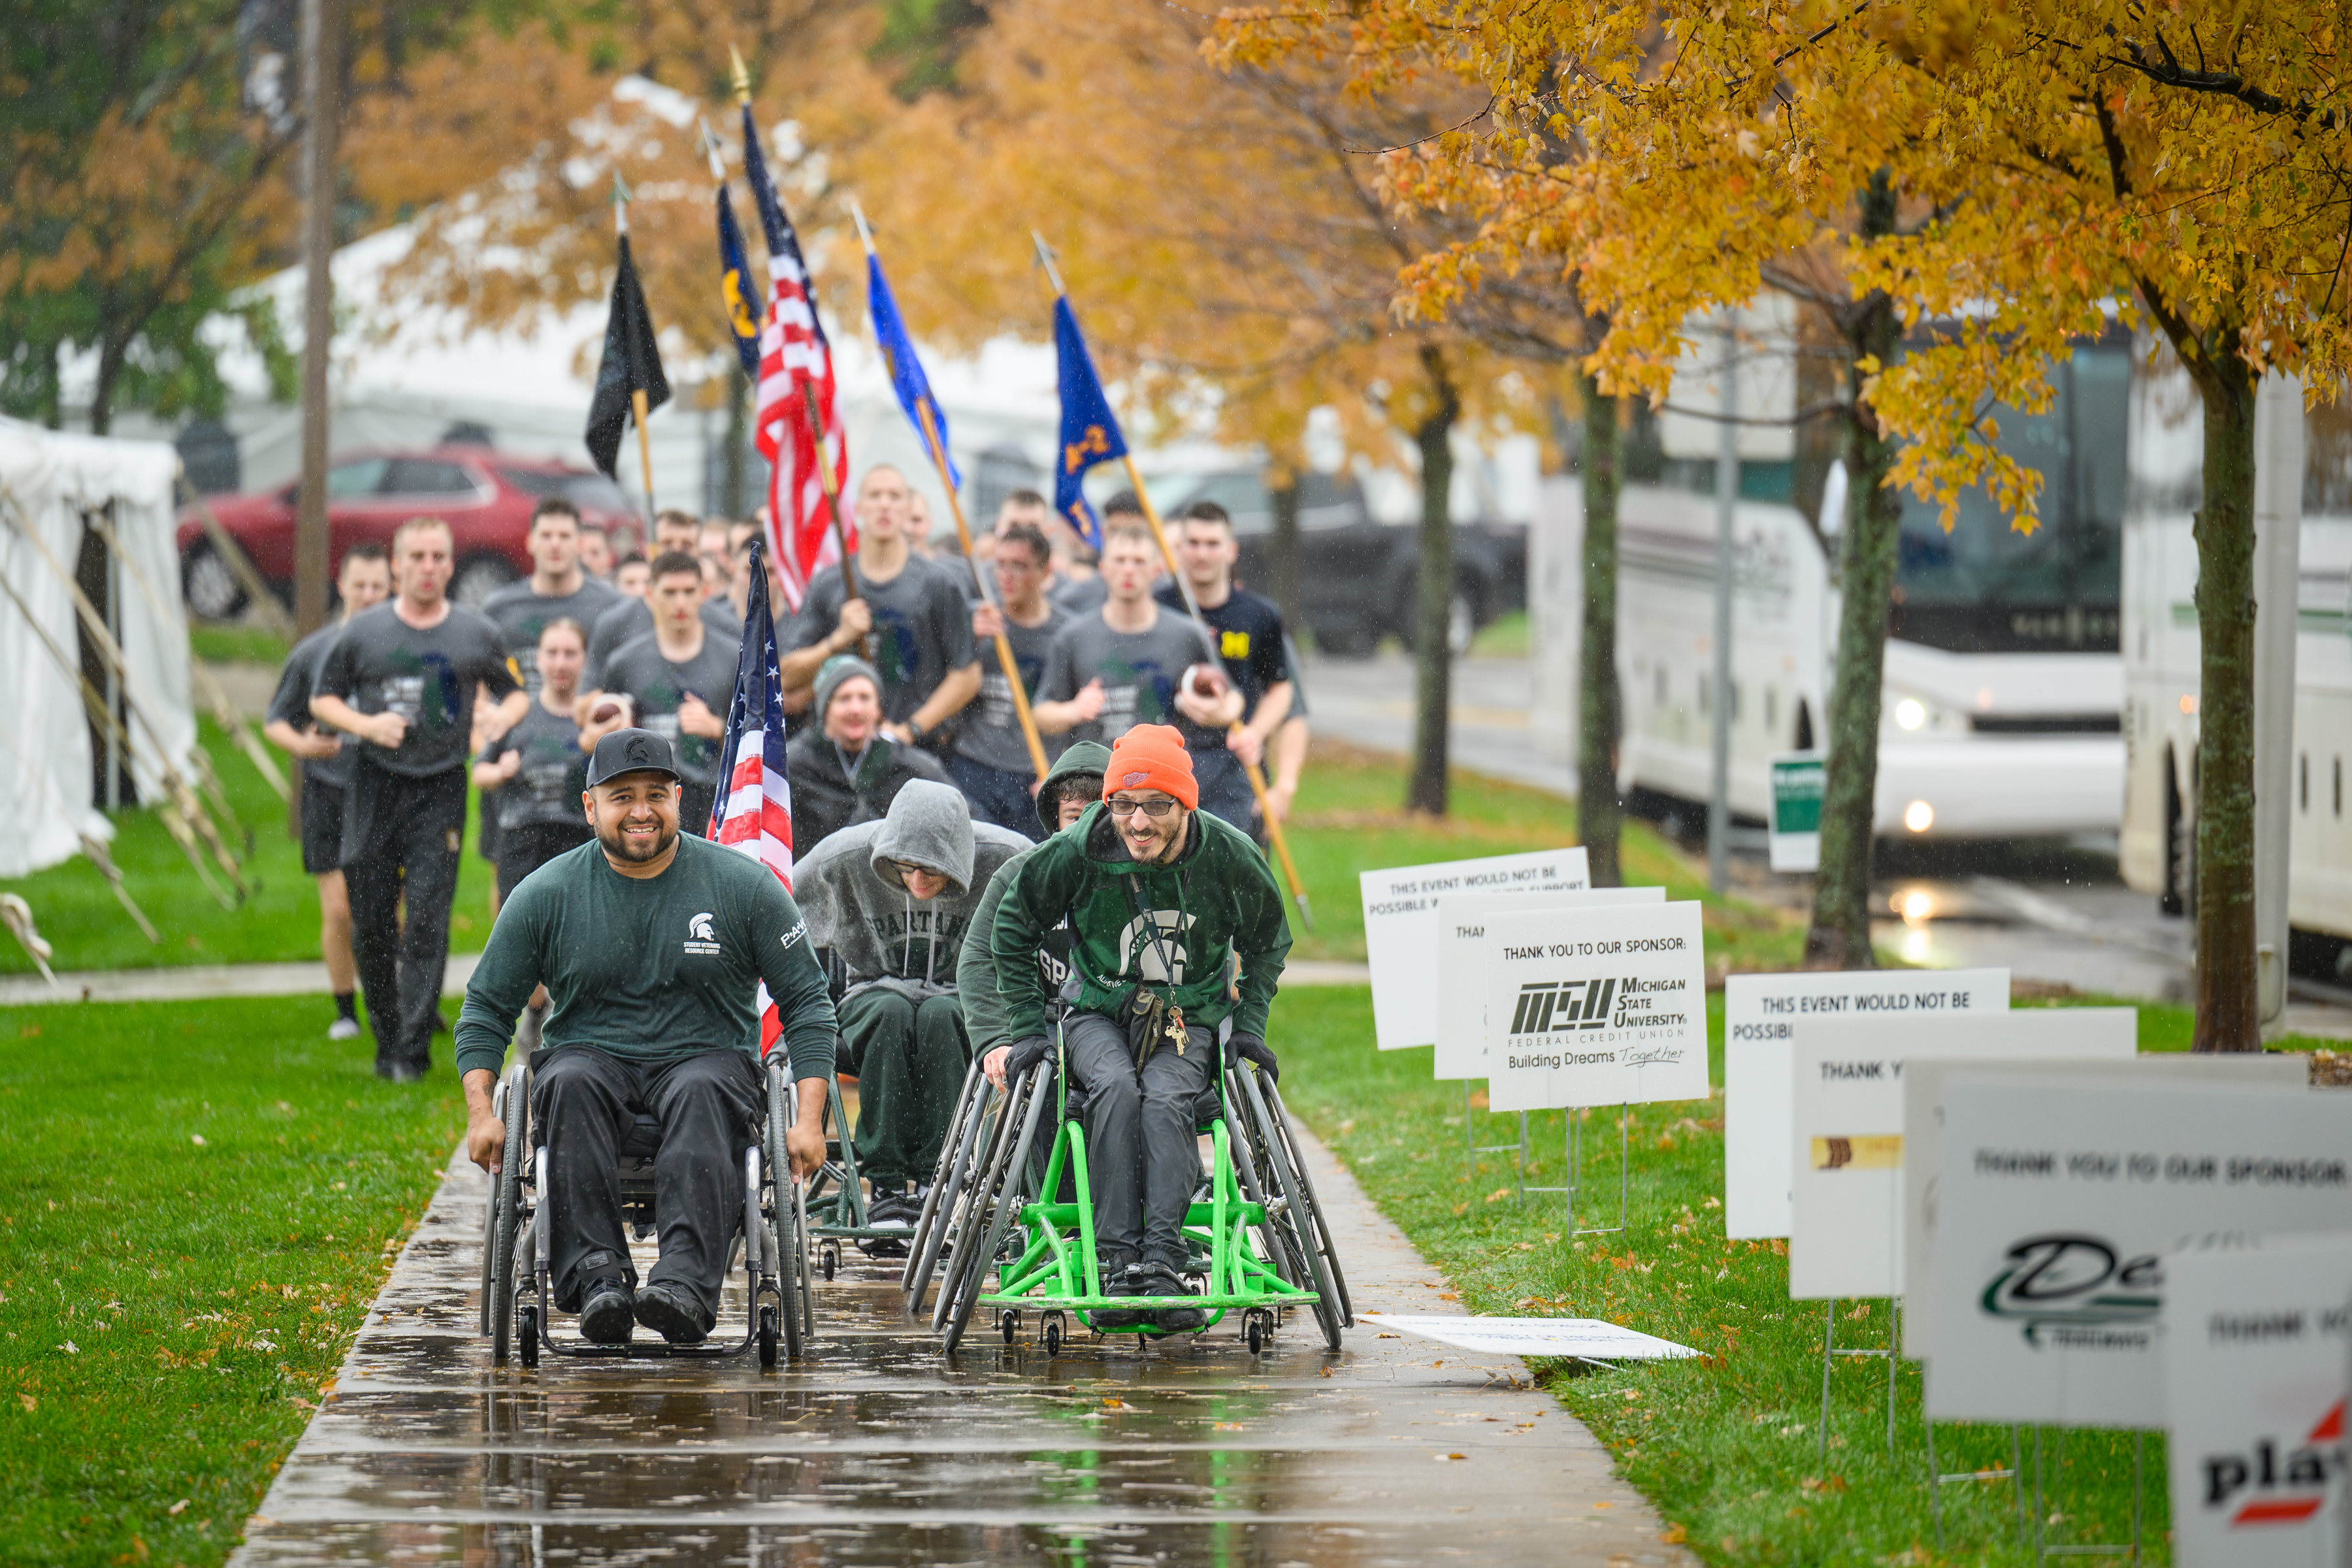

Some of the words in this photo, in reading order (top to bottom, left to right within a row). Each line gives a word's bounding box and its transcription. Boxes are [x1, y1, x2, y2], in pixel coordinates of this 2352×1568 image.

[1390, 883, 1417, 896] THIS
[1422, 877, 1459, 892] EVENT
[1463, 872, 1508, 887] WOULD
[1512, 868, 1537, 881] NOT
[1542, 866, 1556, 878] BE
[1369, 898, 1426, 915] POSSIBLE
[1456, 926, 1484, 938] THAN
[1504, 946, 1544, 960] THANK
[1549, 944, 1573, 957] YOU
[1577, 943, 1593, 955] TO
[1597, 941, 1622, 954] OUR
[1626, 938, 1686, 953] SPONSOR:
[1039, 948, 1073, 986] SP
[1621, 977, 1686, 994] MICHIGAN
[1617, 995, 1652, 1010] STATE
[1761, 996, 1795, 1013] THIS
[1801, 995, 1849, 1012] EVENT
[1855, 994, 1909, 1010] WOULD
[1915, 992, 1946, 1009] NOT
[1952, 992, 1970, 1008] BE
[1508, 1036, 1570, 1048] FEDERAL
[1580, 1032, 1631, 1044] CREDIT
[1639, 1028, 1684, 1040] UNION
[1509, 1054, 1560, 1070] Building
[1565, 1051, 1615, 1065] Dreams
[1620, 1046, 1685, 1068] Together
[1820, 1061, 1884, 1079] THANK
